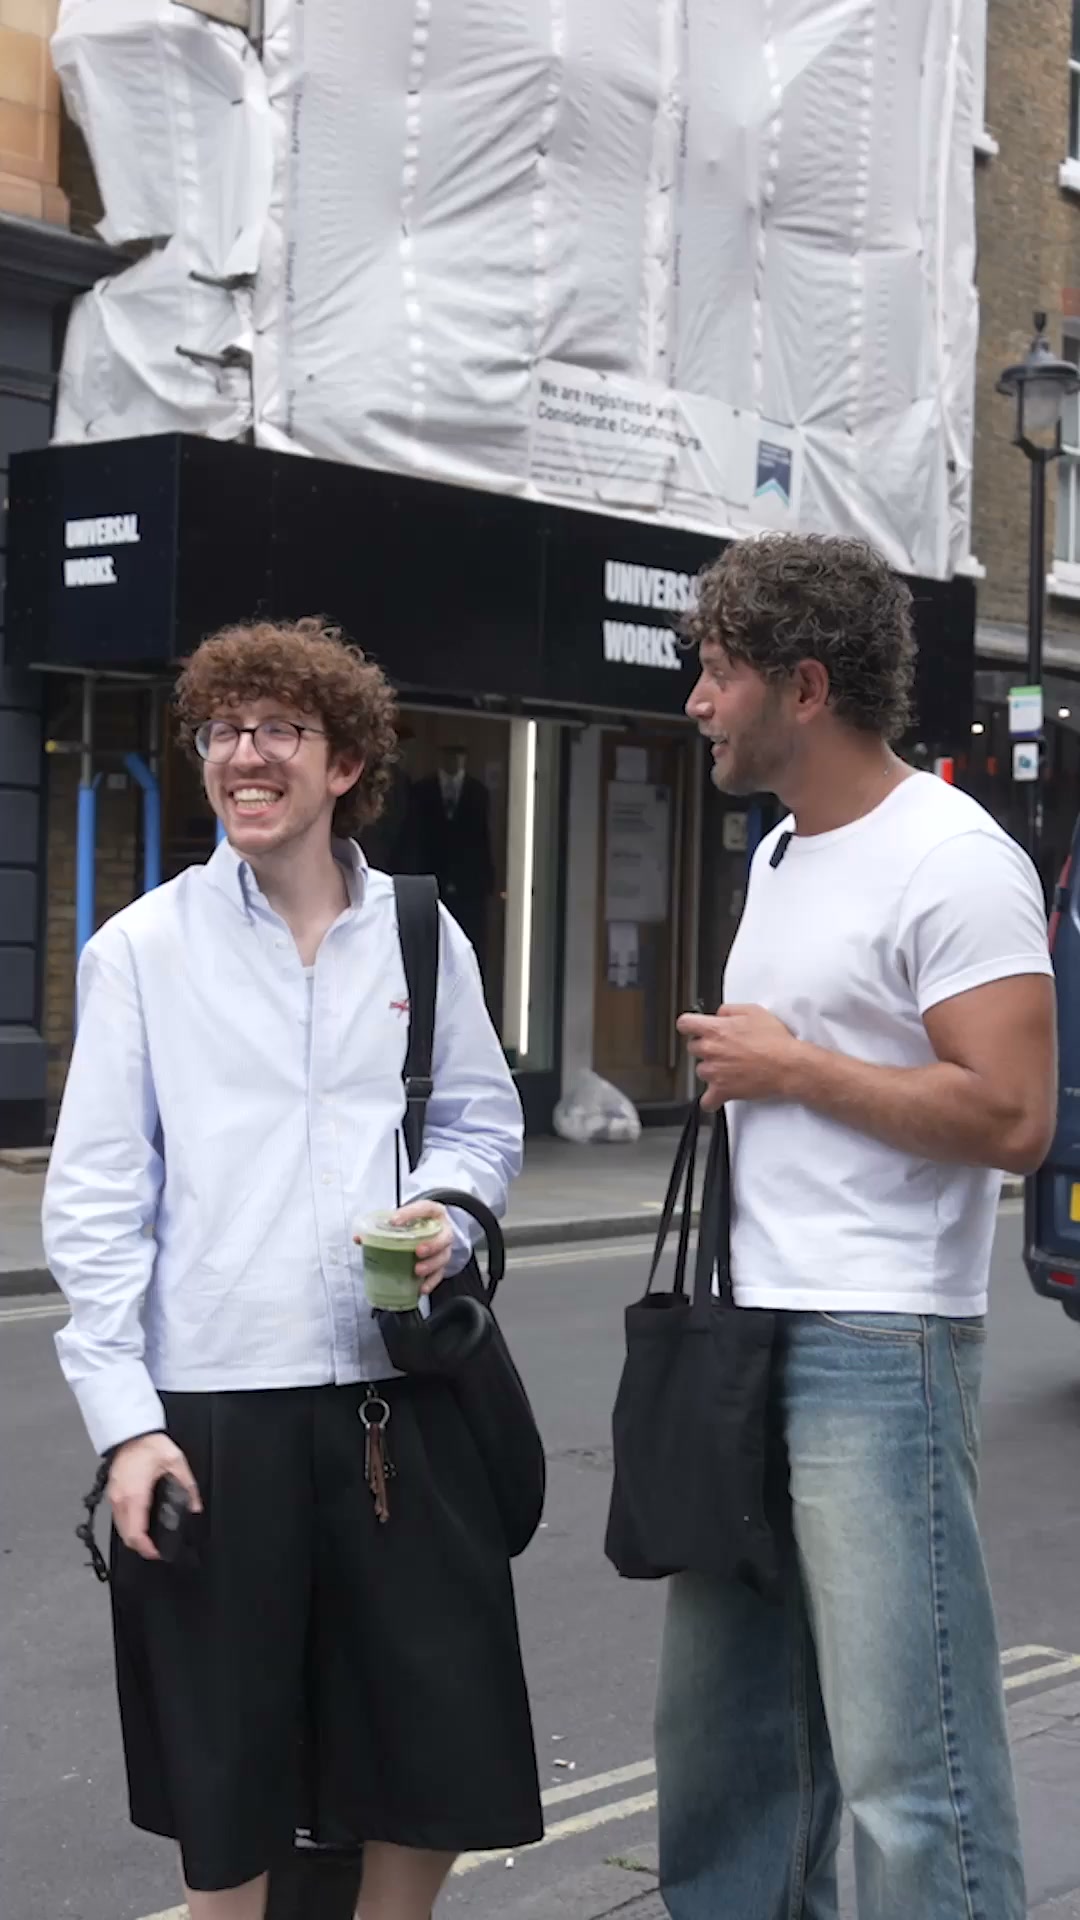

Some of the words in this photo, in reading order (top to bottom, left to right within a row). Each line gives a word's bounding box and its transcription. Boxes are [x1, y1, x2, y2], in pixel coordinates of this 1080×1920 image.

[540, 381, 558, 398] We
[561, 387, 581, 402] are
[584, 391, 652, 416] registered
[538, 400, 617, 433] Considerate
[65, 513, 141, 549] UNIVERSAL
[63, 555, 118, 588] WORKS.
[604, 559, 702, 613] UNIVERSA
[602, 619, 682, 671] WORKS.
